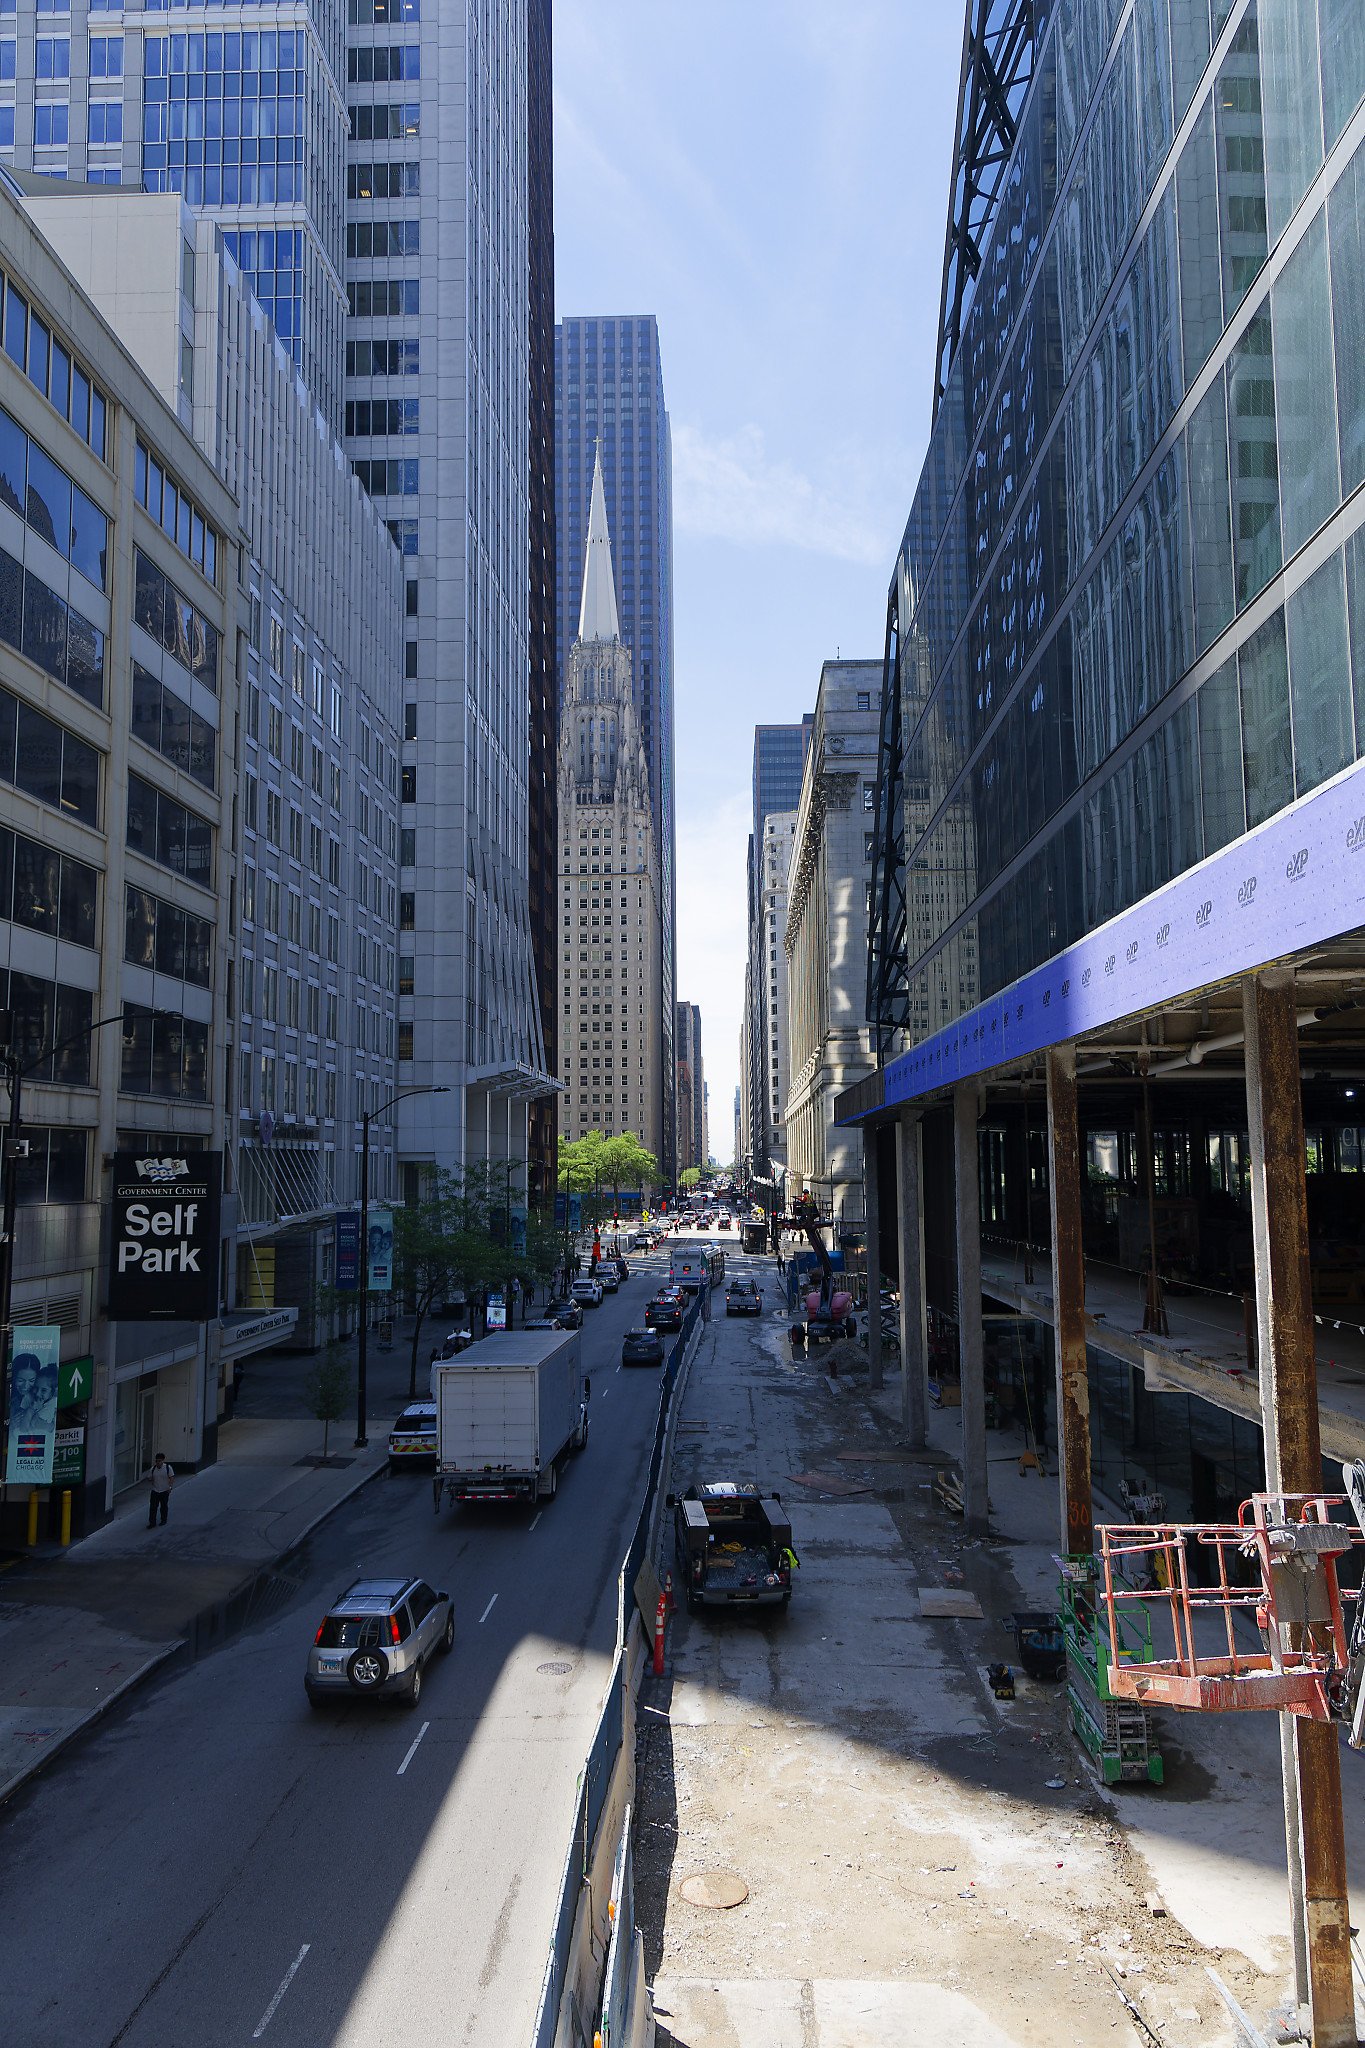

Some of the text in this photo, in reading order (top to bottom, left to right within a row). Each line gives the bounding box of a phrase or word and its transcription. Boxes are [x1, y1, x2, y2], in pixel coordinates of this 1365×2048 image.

[1286, 848, 1309, 879] eXP
[1238, 876, 1257, 904] eXP
[1195, 900, 1212, 925] eXP
[1156, 923, 1170, 945] eXP
[117, 1186, 207, 1196] GOVERNMENT CENTER
[125, 1203, 198, 1236] Self
[118, 1241, 201, 1272] Park
